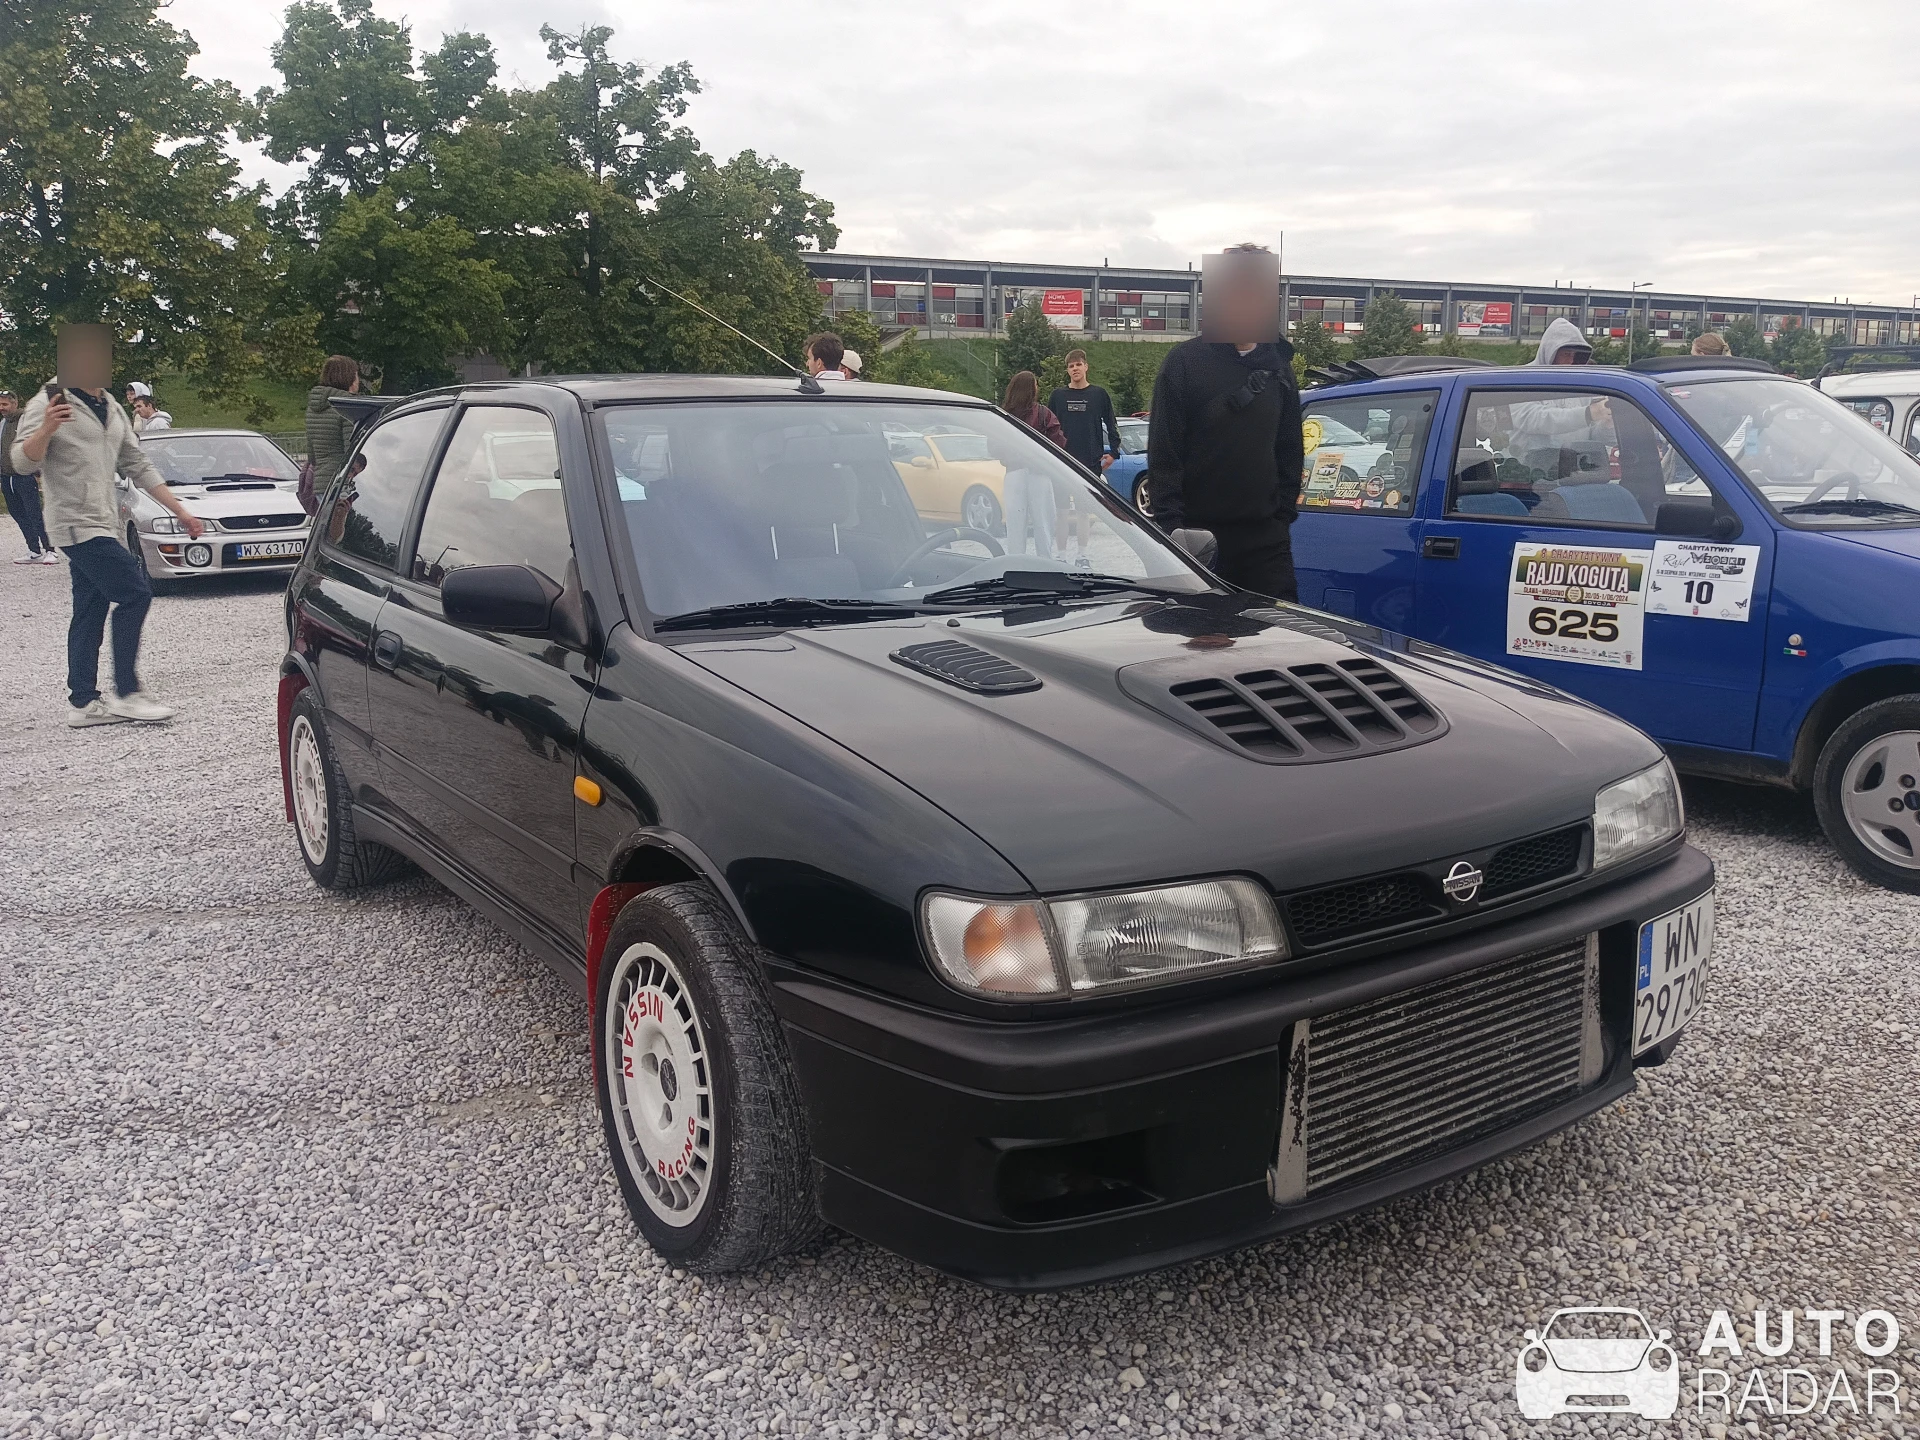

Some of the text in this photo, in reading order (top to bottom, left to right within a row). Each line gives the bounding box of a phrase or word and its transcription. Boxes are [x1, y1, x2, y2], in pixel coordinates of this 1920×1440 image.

[243, 545, 261, 556] WX
[265, 542, 302, 555] 63170
[1551, 549, 1623, 564] CHARYTATYWNY
[1662, 554, 1690, 568] Rajd
[1678, 544, 1735, 553] CHARYTATYWNY
[1526, 560, 1630, 593] RAJD KOGUTA
[1684, 580, 1714, 605] 10
[1528, 606, 1619, 643] 625
[1449, 874, 1481, 890] NISSAN
[1665, 906, 1701, 973] WN
[1639, 964, 1650, 980] PL
[1638, 957, 1707, 1047] 2973G
[623, 991, 663, 1078] NISSAN
[658, 1116, 696, 1180] RACING
